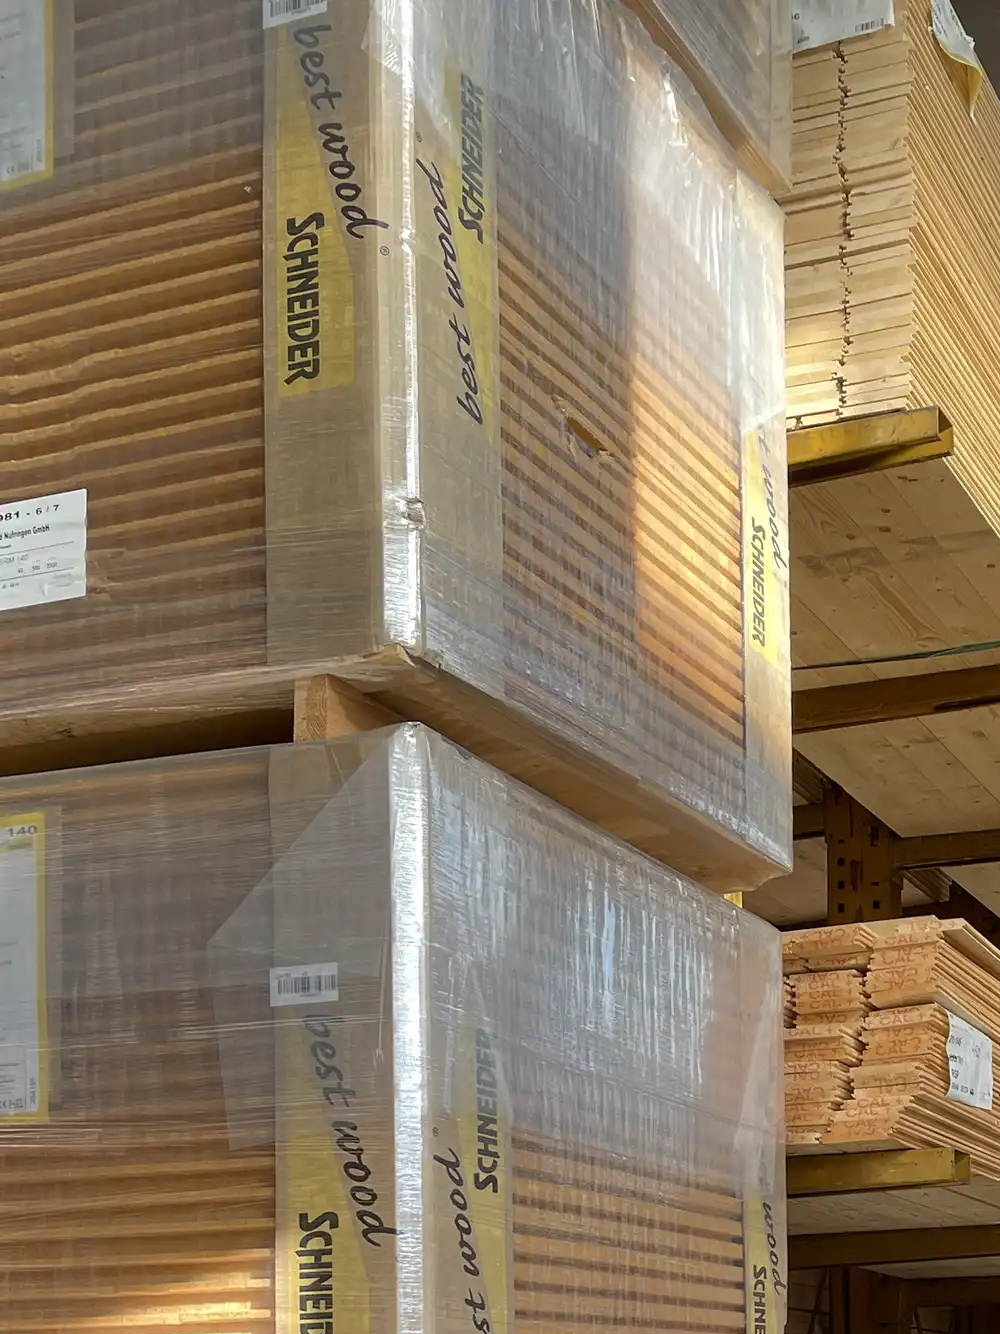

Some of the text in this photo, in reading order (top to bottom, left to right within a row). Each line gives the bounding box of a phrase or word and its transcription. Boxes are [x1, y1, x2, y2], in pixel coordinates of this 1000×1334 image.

[293, 24, 342, 110] best
[318, 122, 389, 239] wood
[458, 73, 486, 245] SCHNEIDER
[282, 212, 325, 386] SCHNEIDER
[416, 158, 483, 425] best wood
[751, 516, 766, 648] SCHNEIDER
[761, 463, 787, 570] wood
[7, 825, 37, 838] 140
[300, 1014, 401, 1248] best wood
[474, 1027, 500, 1193] SCHNEIDER
[433, 1147, 481, 1277] wood
[762, 1201, 787, 1296] wood
